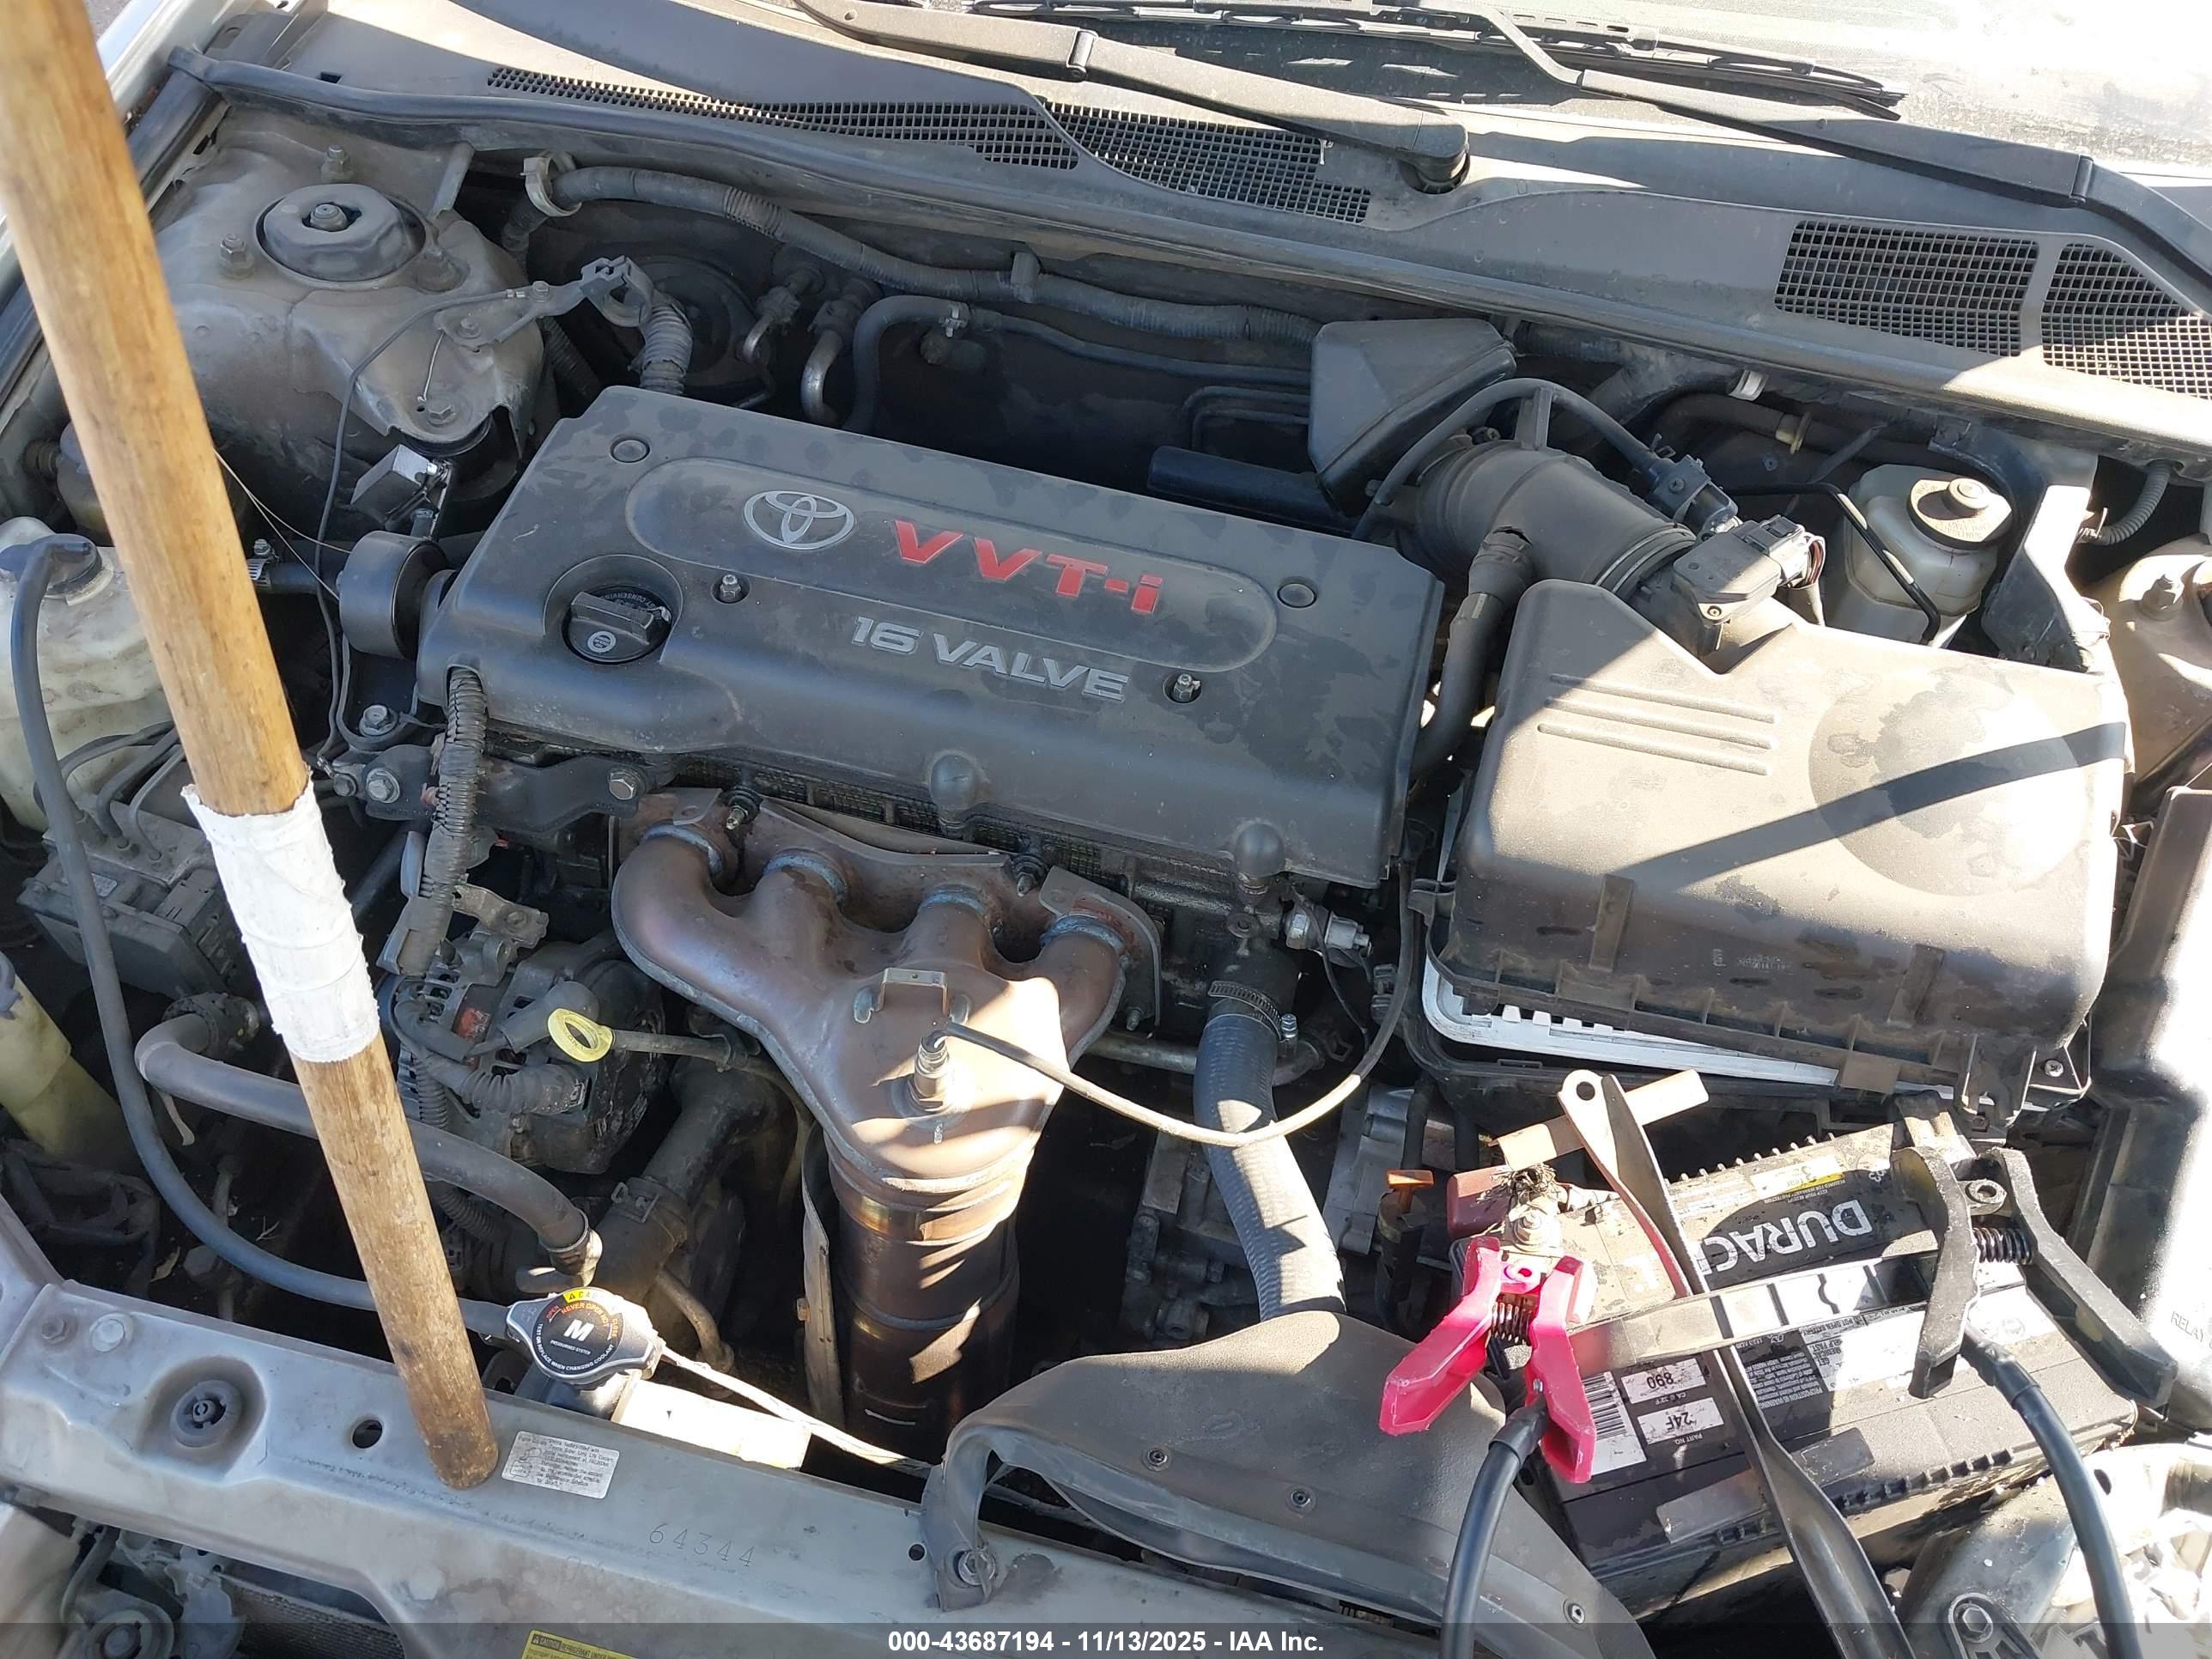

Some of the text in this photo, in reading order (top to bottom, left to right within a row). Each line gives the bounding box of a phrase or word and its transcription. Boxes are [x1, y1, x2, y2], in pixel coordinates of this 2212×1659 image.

[893, 520, 1164, 616] VVT-i
[851, 617, 1130, 703] 16 VALVE
[563, 1319, 595, 1342] M
[1646, 1372, 1674, 1390] 890
[1666, 1411, 1692, 1430] 24F
[649, 1522, 757, 1568] 64344
